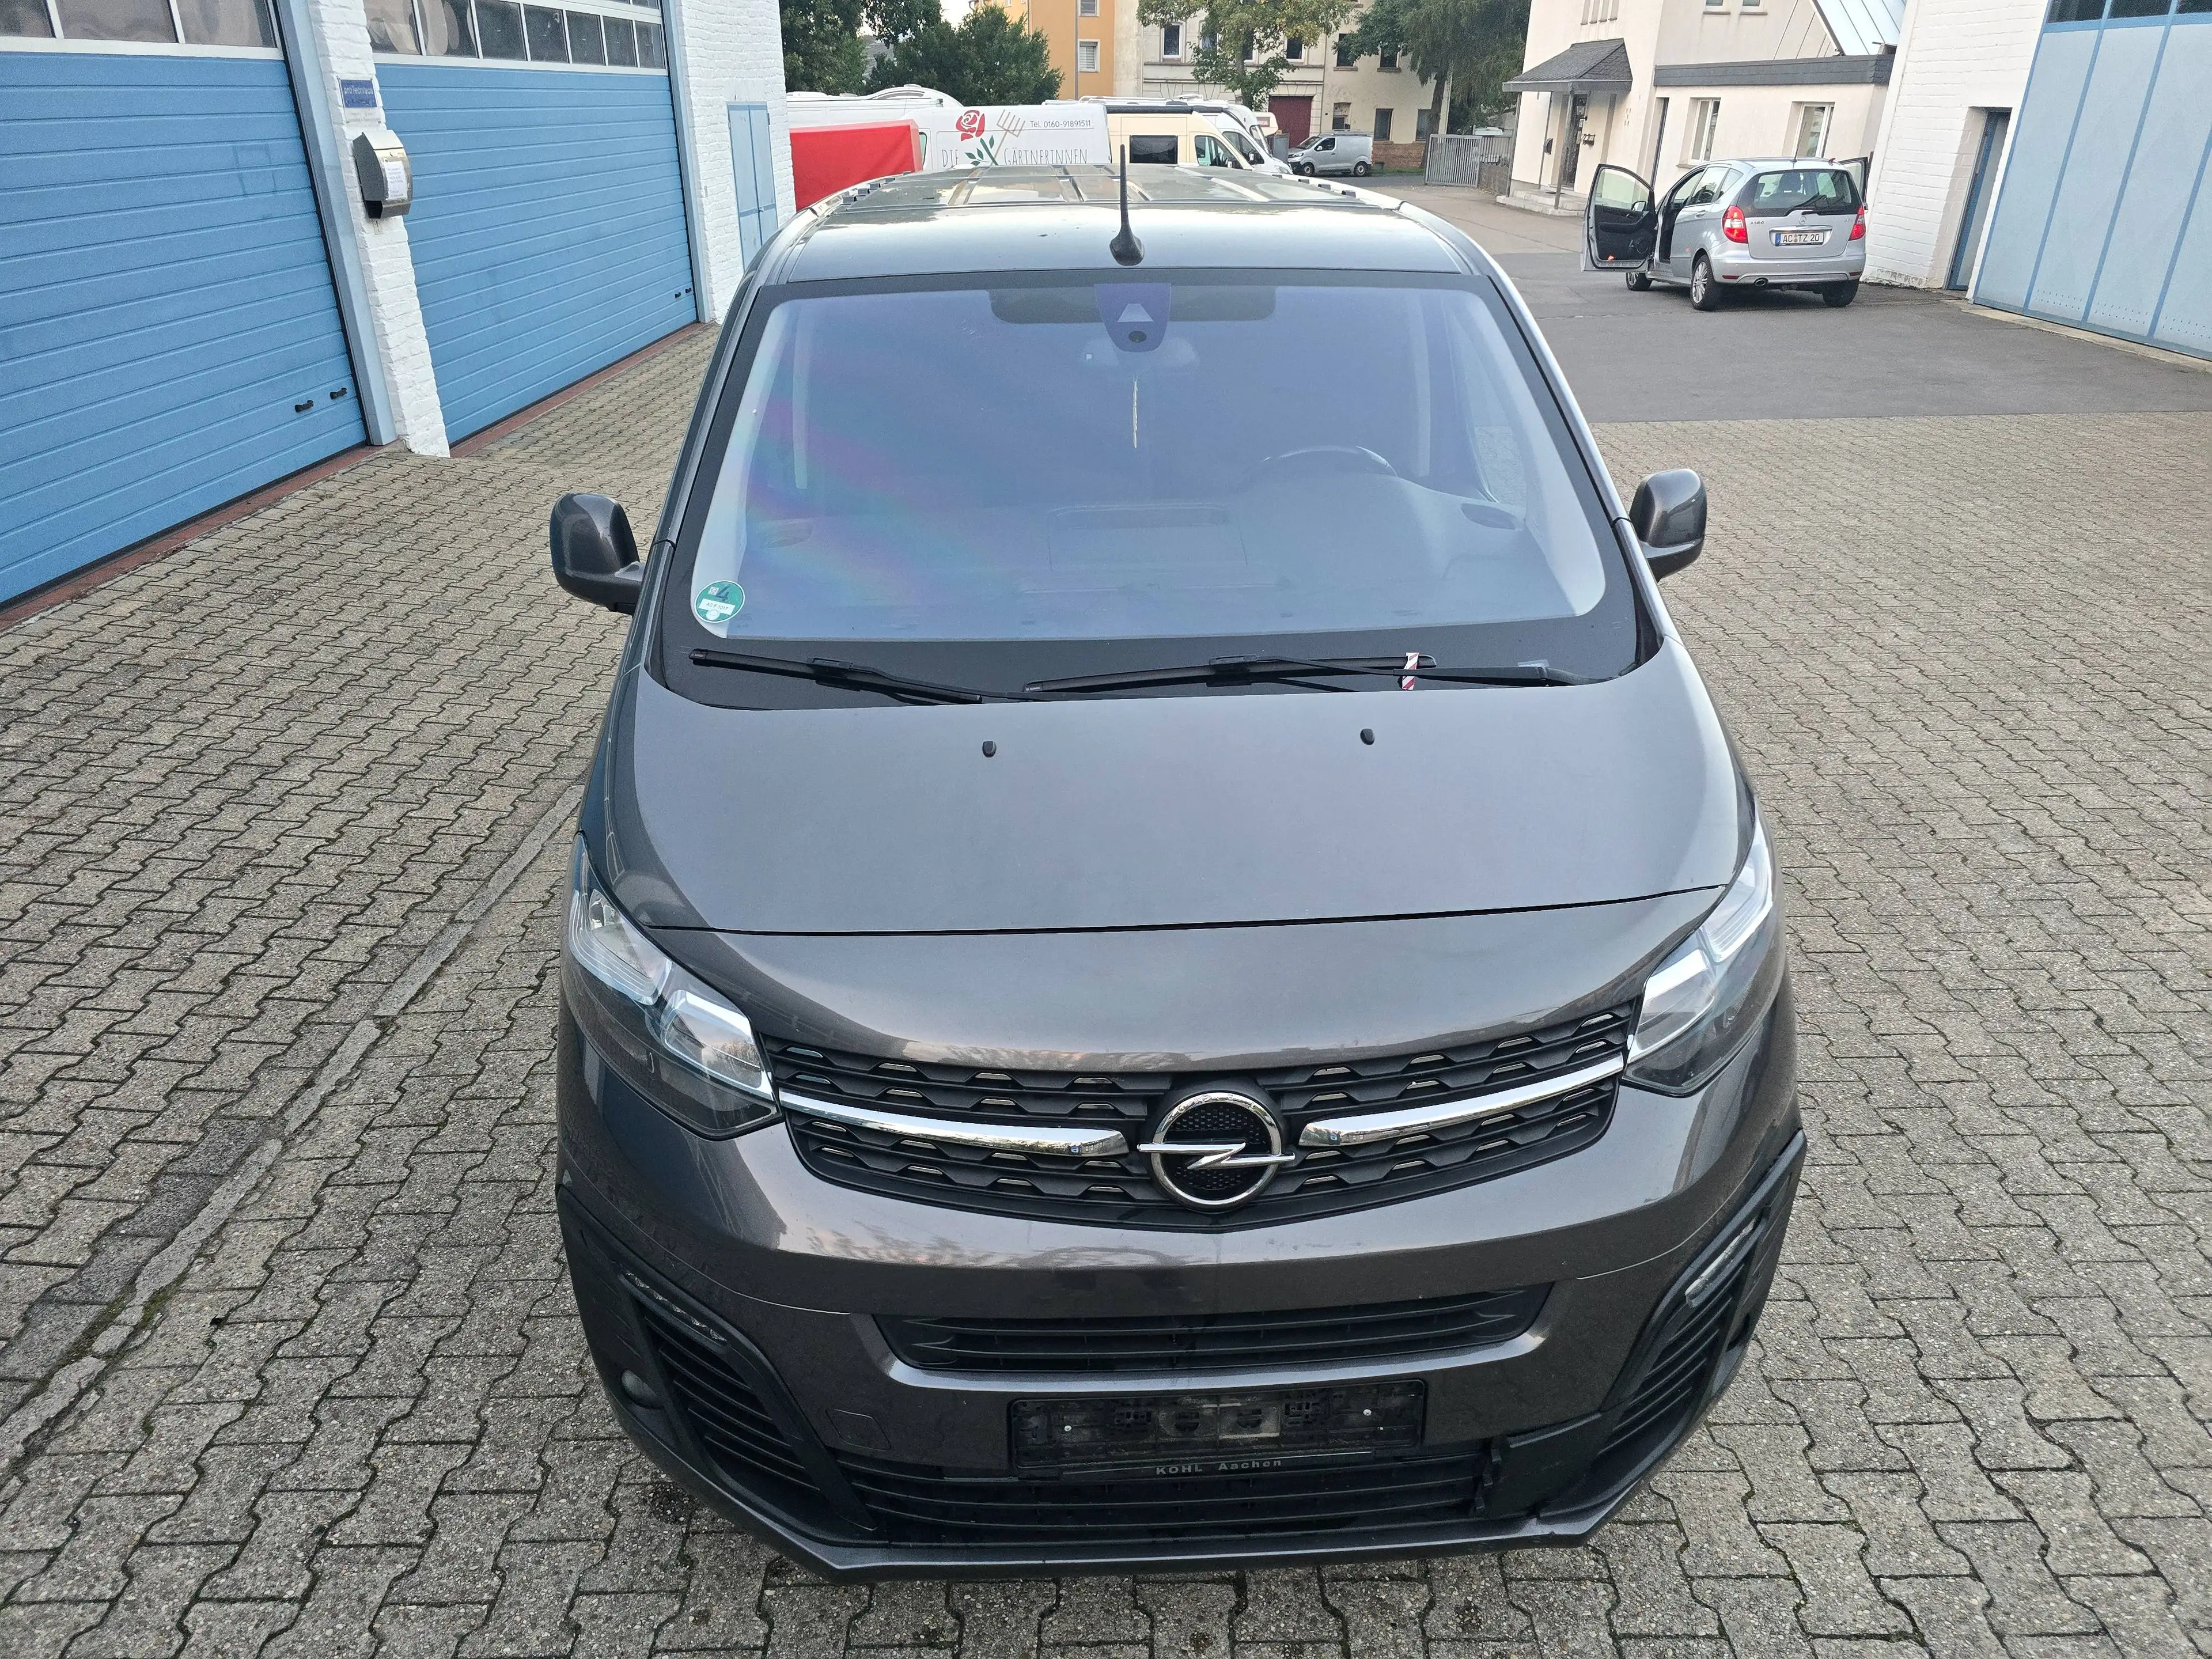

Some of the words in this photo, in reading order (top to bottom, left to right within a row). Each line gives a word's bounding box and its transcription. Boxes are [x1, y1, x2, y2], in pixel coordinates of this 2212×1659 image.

[1030, 120, 1041, 128] Tel.
[1043, 120, 1091, 128] 0160-91891511
[942, 149, 959, 168] DIE
[1004, 147, 1088, 165] GÄRTNERINNEN
[1783, 234, 1793, 243] AC
[1798, 234, 1808, 242] TZ
[1810, 233, 1820, 241] 20
[715, 584, 730, 601] 4
[1156, 1464, 1203, 1475] KOHL
[1218, 1460, 1282, 1471] Aachen
